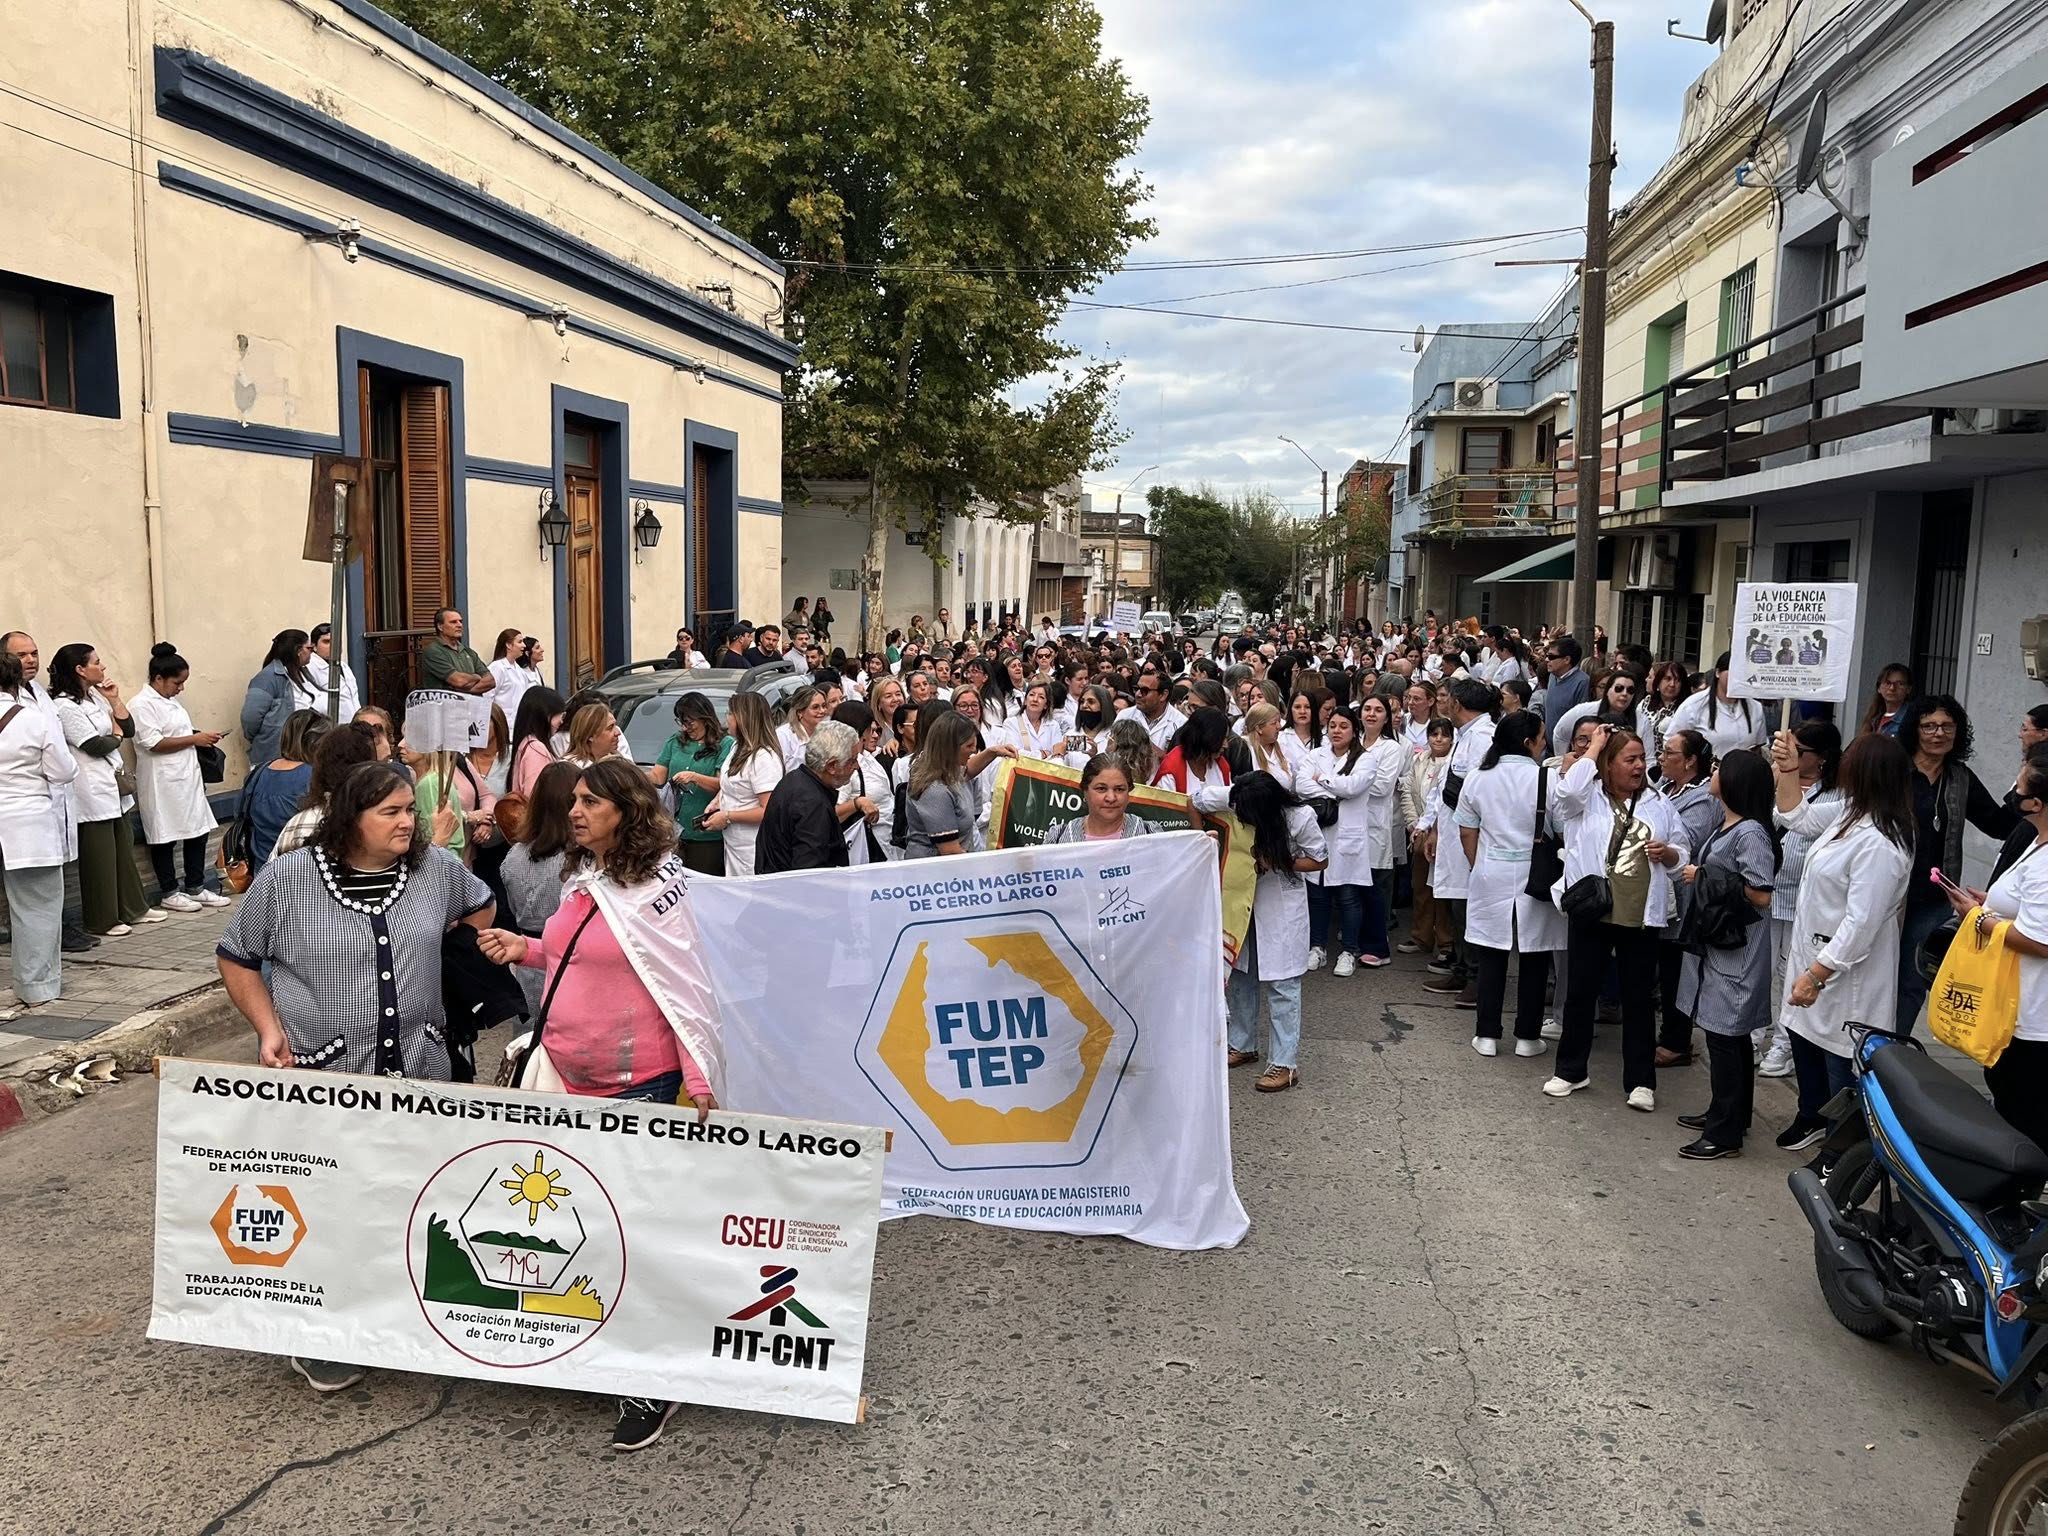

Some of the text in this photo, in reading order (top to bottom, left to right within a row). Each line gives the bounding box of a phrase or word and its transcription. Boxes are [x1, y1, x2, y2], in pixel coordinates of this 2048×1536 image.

[1755, 590, 1826, 602] LA VIOLENCIA
[1757, 602, 1823, 612] NO ES PARTE
[1753, 612, 1826, 622] DE LA EDUCACIÓN
[1049, 789, 1082, 812] NO
[1100, 865, 1131, 880] CSEU
[870, 867, 1084, 902] ASOCIACIÓN MAGISTERIA
[910, 884, 1057, 912] DE CERRO LARGO
[1098, 911, 1147, 928] PIT-CNT
[935, 997, 1048, 1044] FUM
[948, 1045, 1045, 1088] TEP
[192, 1075, 861, 1158] ASOCIACIÓN MAGISTERIAL DE CERRO LARGO
[182, 1145, 338, 1169] FEDERACIÓN URUGUAYA
[209, 1162, 312, 1177] DE MAGISTERIO
[901, 1185, 1131, 1201] FEDERACIÓN URUGUAYA DE MAGISTERIO
[236, 1208, 284, 1226] FUM
[980, 1205, 995, 1218] DE
[998, 1207, 1012, 1218] LA
[1014, 1203, 1083, 1218] EDUCACIÓN
[1085, 1204, 1143, 1217] PRIMARIA
[238, 1226, 280, 1242] TEP
[721, 1214, 785, 1250] CSEU
[789, 1219, 841, 1231] COORDINADORA
[799, 1229, 837, 1239] SINDICATOS
[786, 1243, 832, 1254] DEL URUGUAY
[808, 1237, 848, 1248] ENSEÑANZA
[185, 1273, 325, 1294] TRABAJADORES DE LA
[186, 1286, 323, 1307] EDUCACIÓN PRIMARIA
[445, 1310, 580, 1334] Asociación Magisterial
[466, 1327, 554, 1348] de Cerro Largo
[712, 1326, 835, 1371] PIT-CNT
